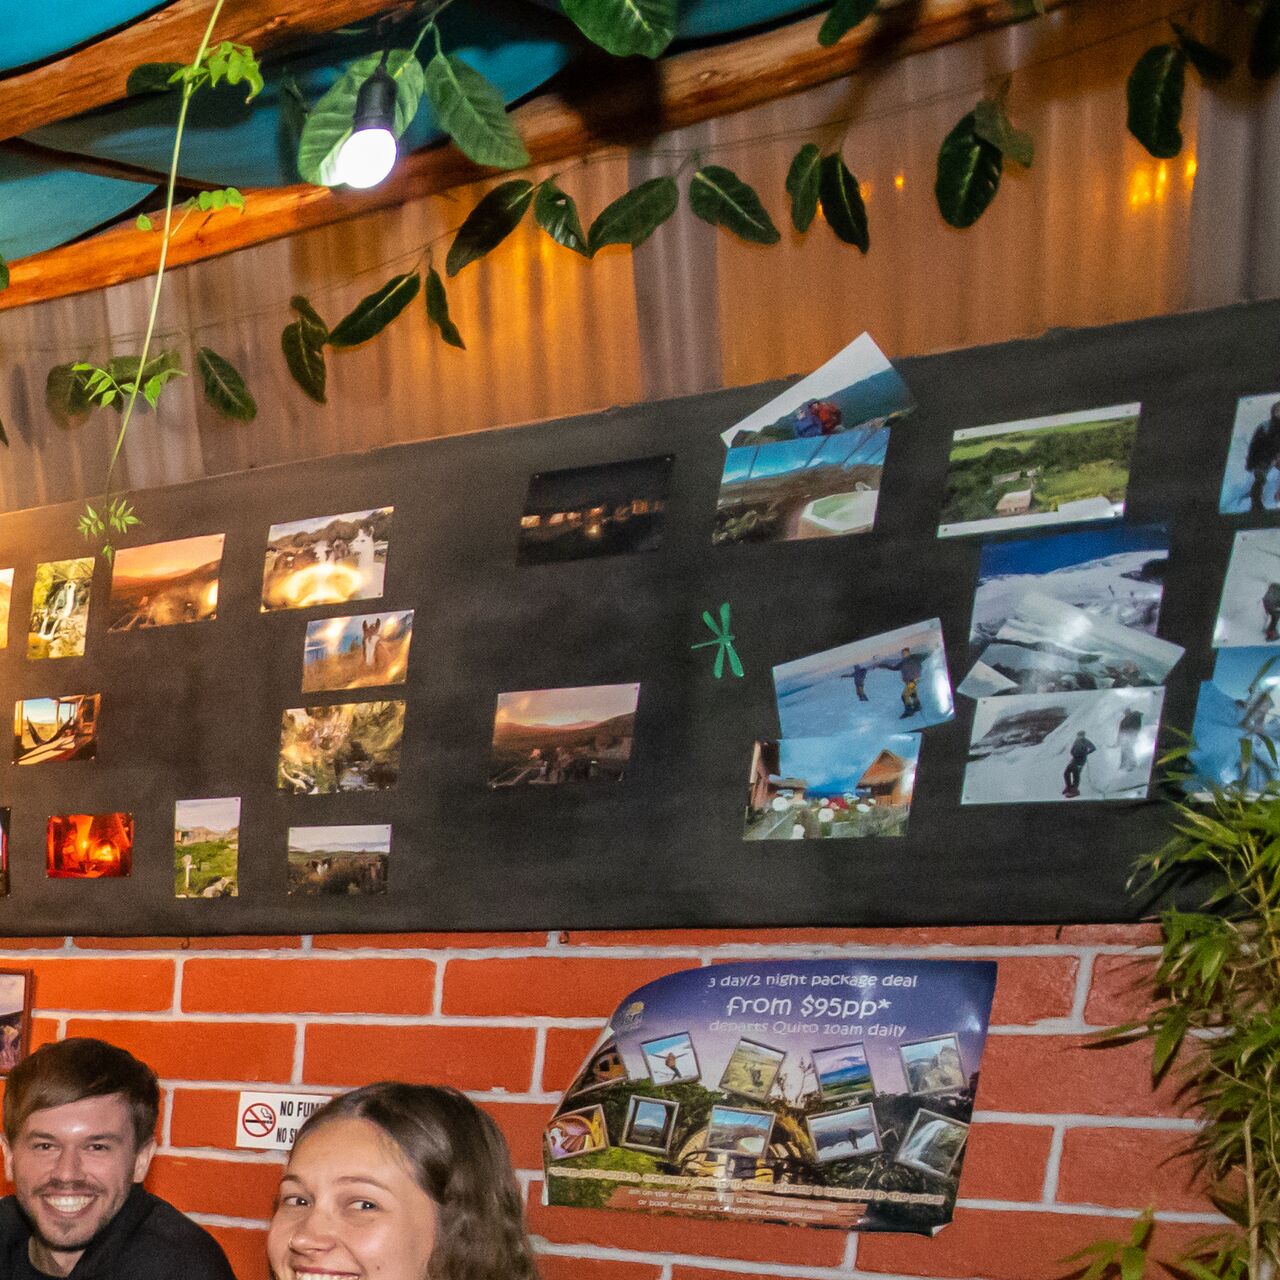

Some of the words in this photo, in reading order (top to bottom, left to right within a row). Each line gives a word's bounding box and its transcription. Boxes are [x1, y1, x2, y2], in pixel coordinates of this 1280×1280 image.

[707, 977, 716, 988] 3
[720, 974, 761, 988] day/2
[766, 974, 807, 987] night
[811, 974, 878, 988] package
[882, 975, 918, 988] deal
[726, 995, 792, 1017] from
[709, 1020, 768, 1034] departs
[772, 1020, 819, 1034] Quito
[823, 1022, 863, 1035] 10am
[867, 1023, 907, 1037] daily
[280, 1101, 294, 1116] NO
[297, 1101, 326, 1118] FUM
[276, 1127, 288, 1143] NO
